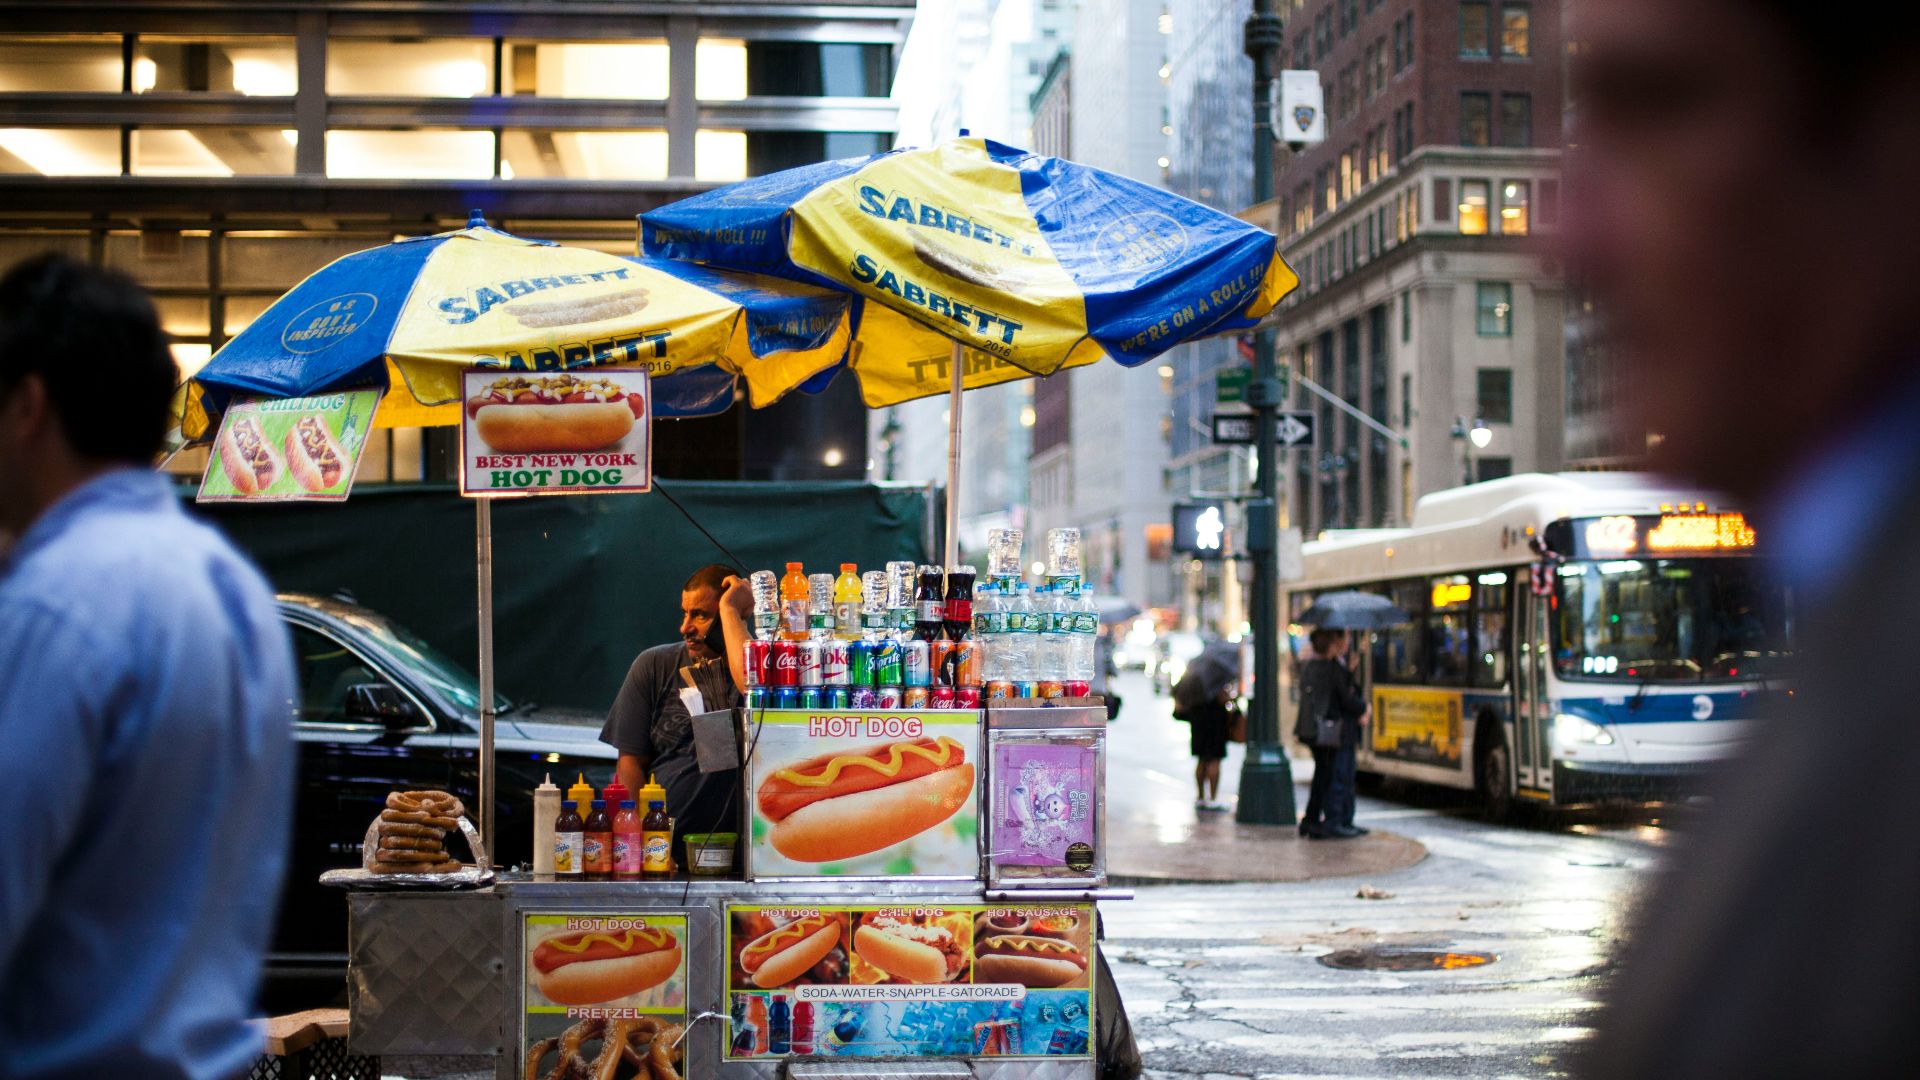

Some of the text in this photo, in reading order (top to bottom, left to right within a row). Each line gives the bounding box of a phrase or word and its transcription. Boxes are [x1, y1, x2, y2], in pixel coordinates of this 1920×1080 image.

[855, 182, 1034, 257] SABRETT
[434, 266, 630, 326] SABRETT
[851, 252, 1024, 346] SABRETT
[1120, 318, 1171, 353] WE'RE
[1172, 304, 1196, 328] ON
[1198, 298, 1210, 315] A
[1210, 274, 1247, 307] ROLL
[287, 322, 358, 342] INSPECTED
[982, 339, 1013, 358] 2016
[260, 392, 346, 412] CHILI DOG
[476, 453, 638, 469] BEST NEW YORK
[490, 468, 624, 488] HOT DOG
[809, 716, 923, 738] HOT DOG
[760, 908, 820, 918] HOT DOG
[878, 907, 944, 918] CHILI DOG
[986, 907, 1078, 918] HOT SAUSAGE
[567, 918, 647, 931] HOT DOG
[802, 986, 1019, 998] SODA-WATER-SNAPPLE-GATORADE
[567, 1007, 643, 1019] PRETZEL
